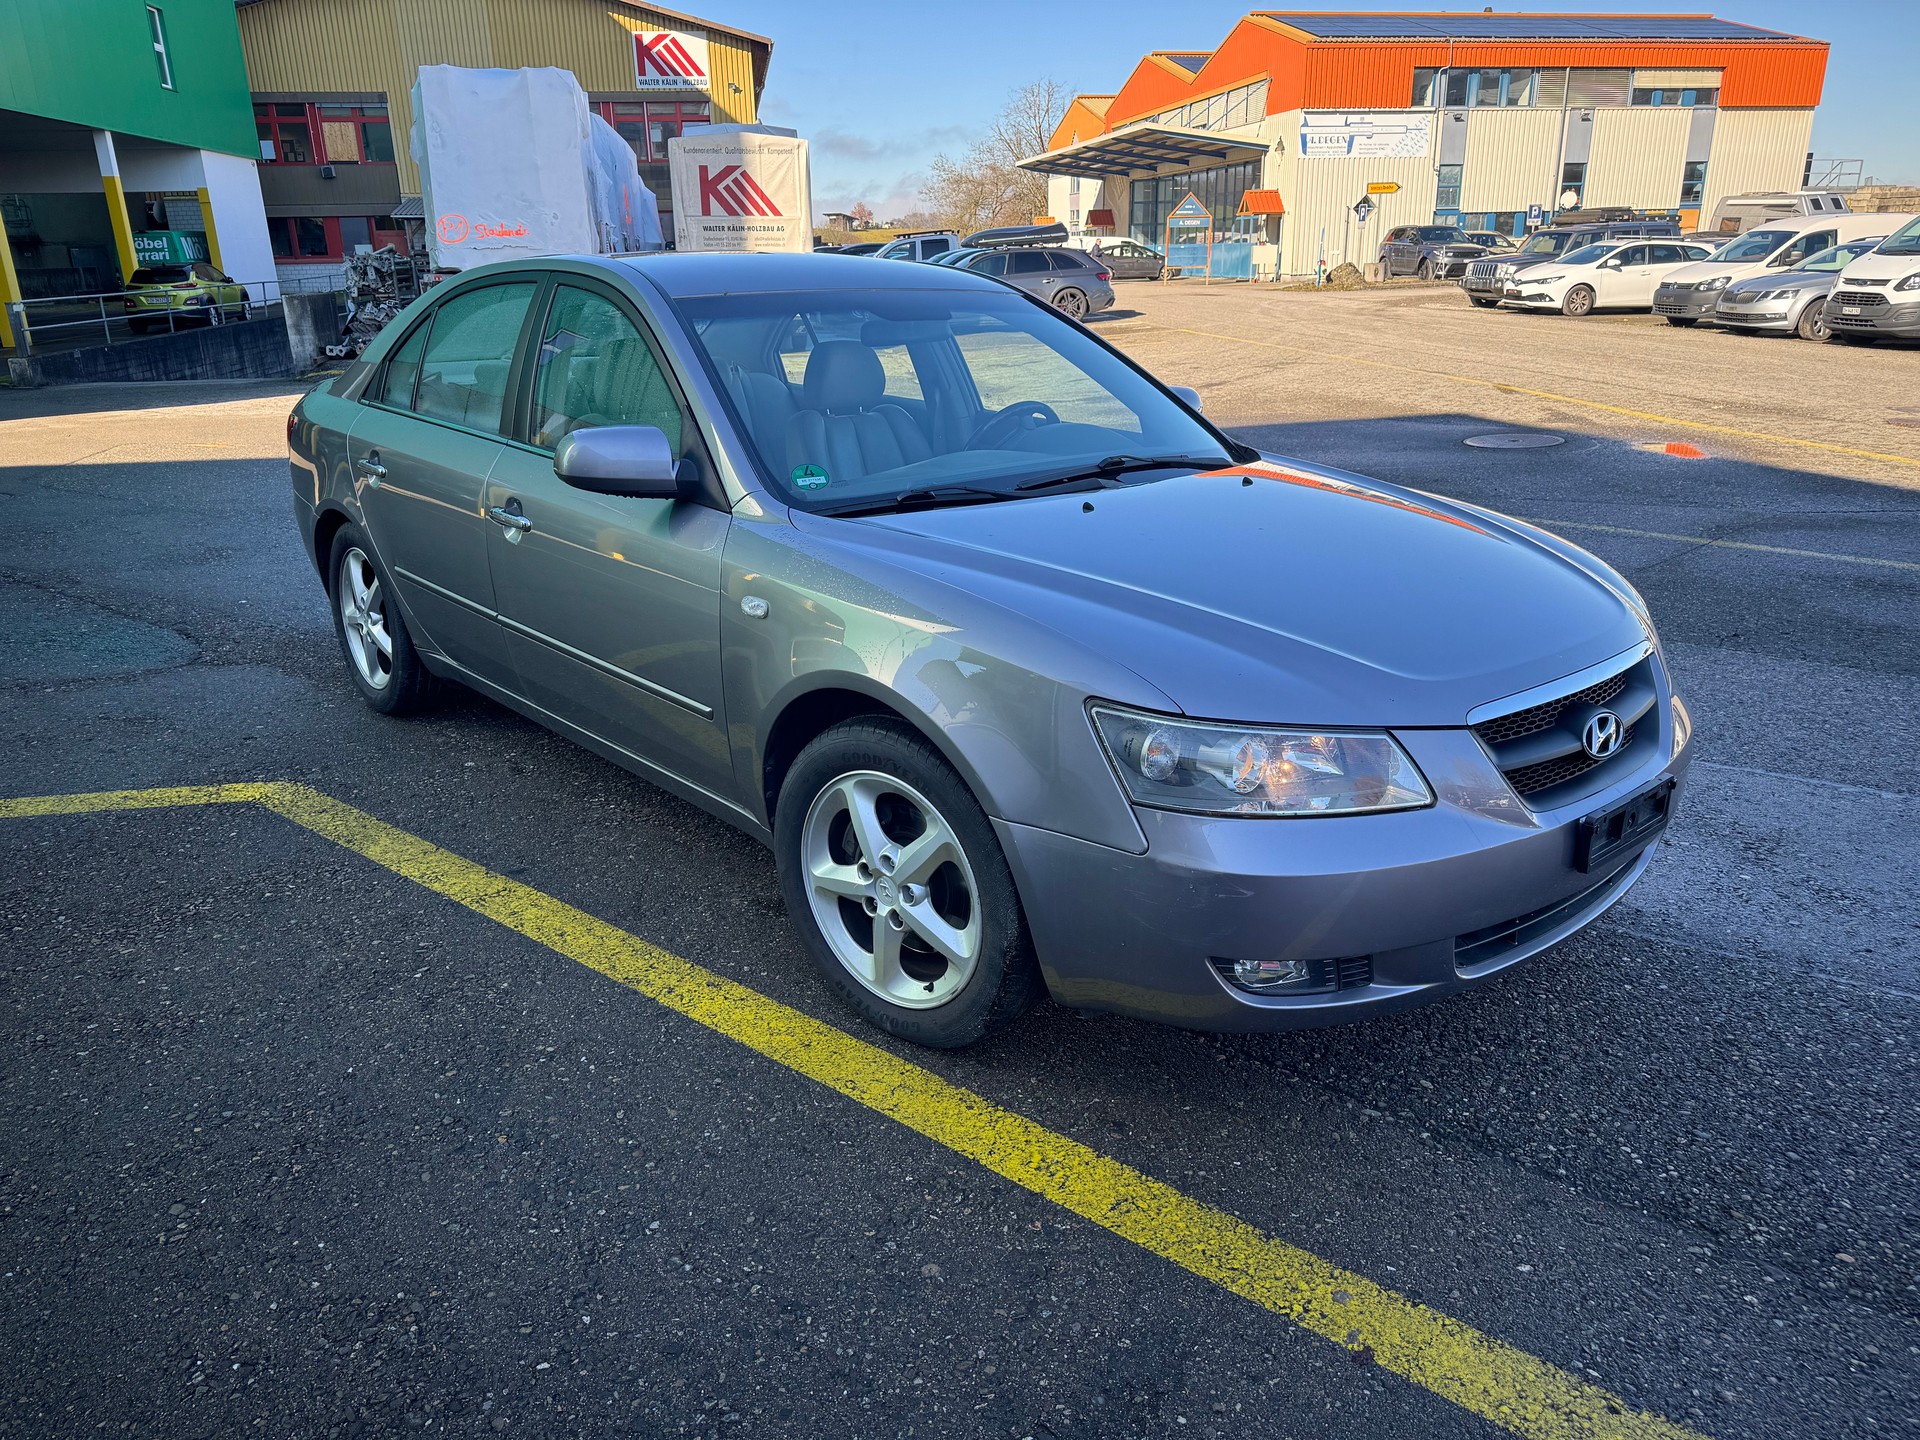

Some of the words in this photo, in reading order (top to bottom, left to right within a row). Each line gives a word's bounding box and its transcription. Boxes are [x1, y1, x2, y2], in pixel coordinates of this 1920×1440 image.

[661, 78, 678, 86] KÄLIN
[1318, 136, 1348, 144] DEGEN
[135, 237, 168, 249] öbel
[804, 465, 815, 477] 4
